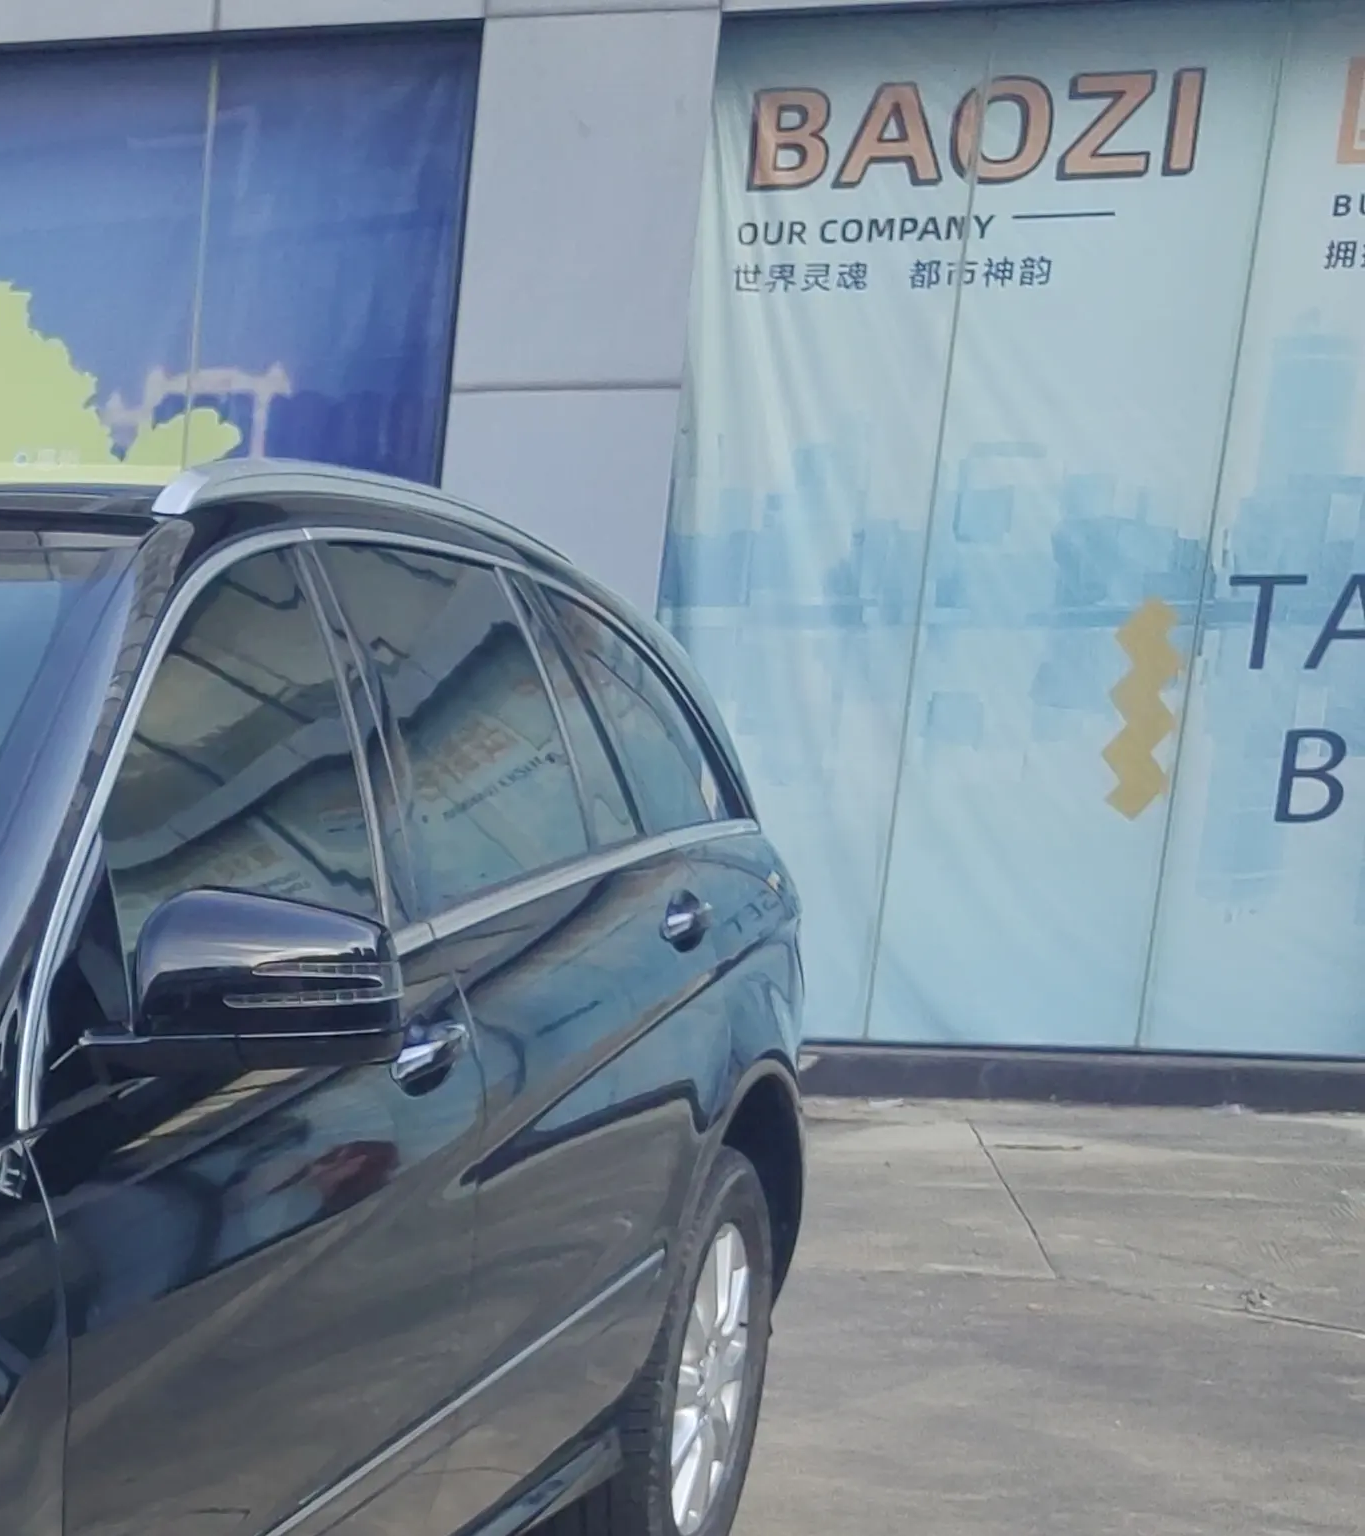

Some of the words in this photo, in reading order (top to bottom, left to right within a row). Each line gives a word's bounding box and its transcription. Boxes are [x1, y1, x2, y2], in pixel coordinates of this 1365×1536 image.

[746, 66, 1207, 192] BAOZI
[1332, 194, 1365, 218] B
[737, 220, 807, 246] OUR
[819, 214, 996, 245] COMPANY
[1324, 239, 1365, 269] 拥
[733, 261, 869, 294] 世界灵魂
[909, 255, 1053, 290] 都市神韵
